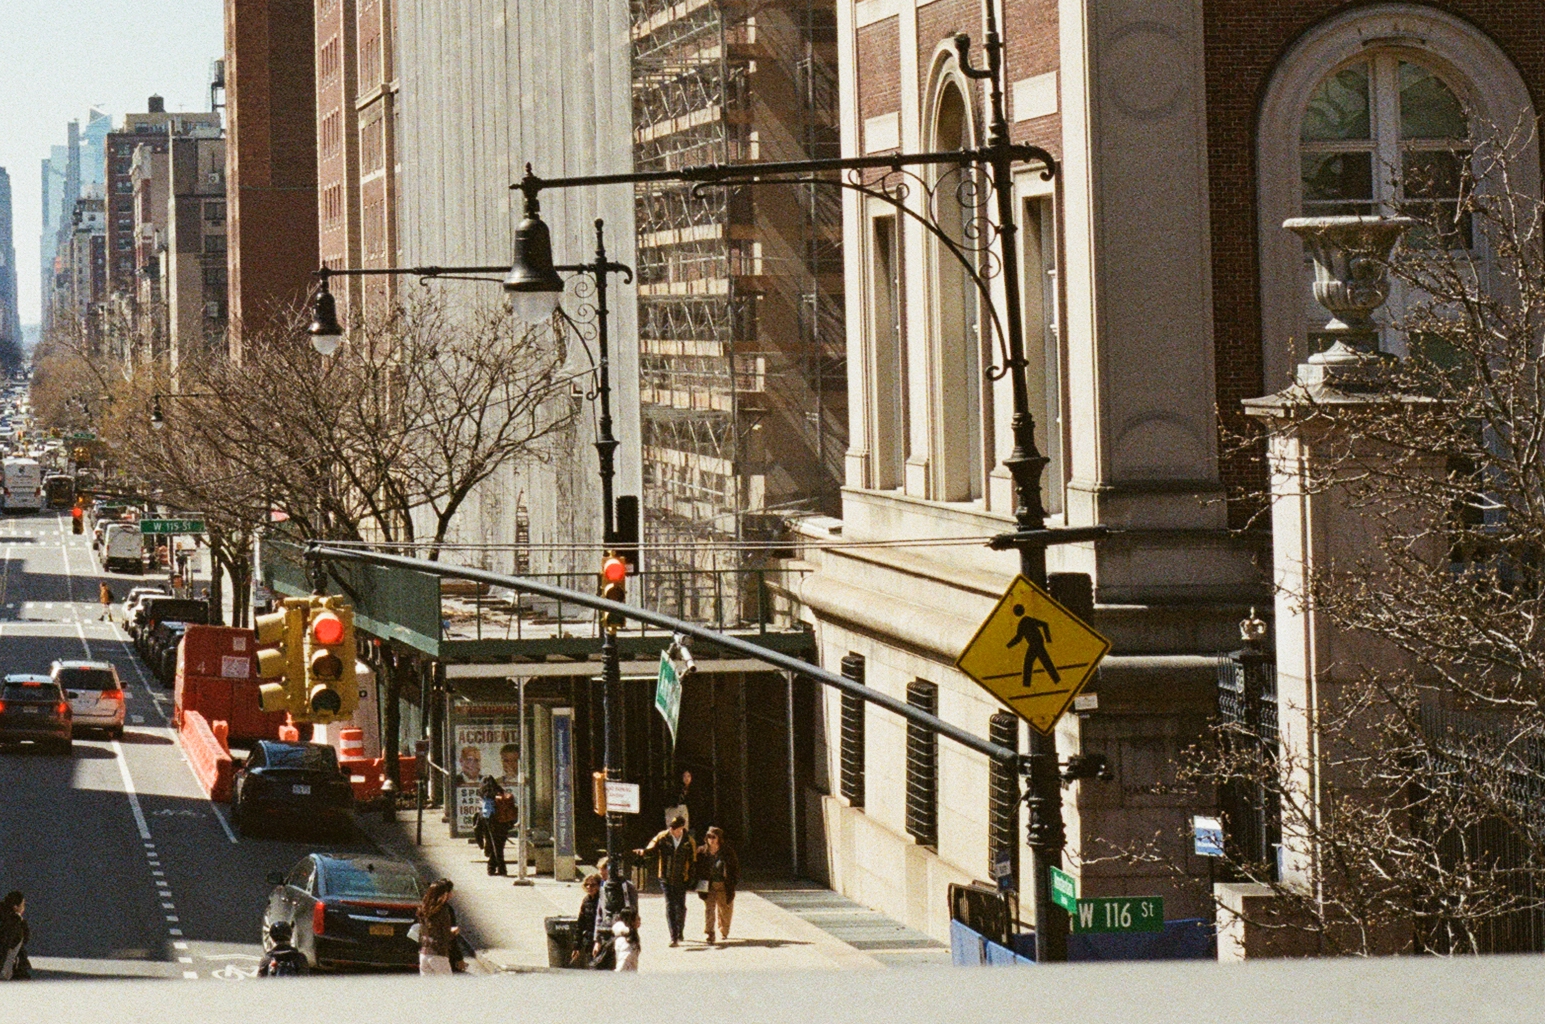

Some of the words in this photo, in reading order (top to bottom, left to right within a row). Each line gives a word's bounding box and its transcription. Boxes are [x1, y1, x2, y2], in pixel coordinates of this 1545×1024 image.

[153, 522, 162, 531] W
[166, 522, 179, 531] 115
[182, 522, 191, 531] St
[458, 729, 517, 745] ACCIDENT
[1078, 903, 1094, 928] W
[1105, 902, 1132, 928] 116
[1141, 901, 1154, 918] St
